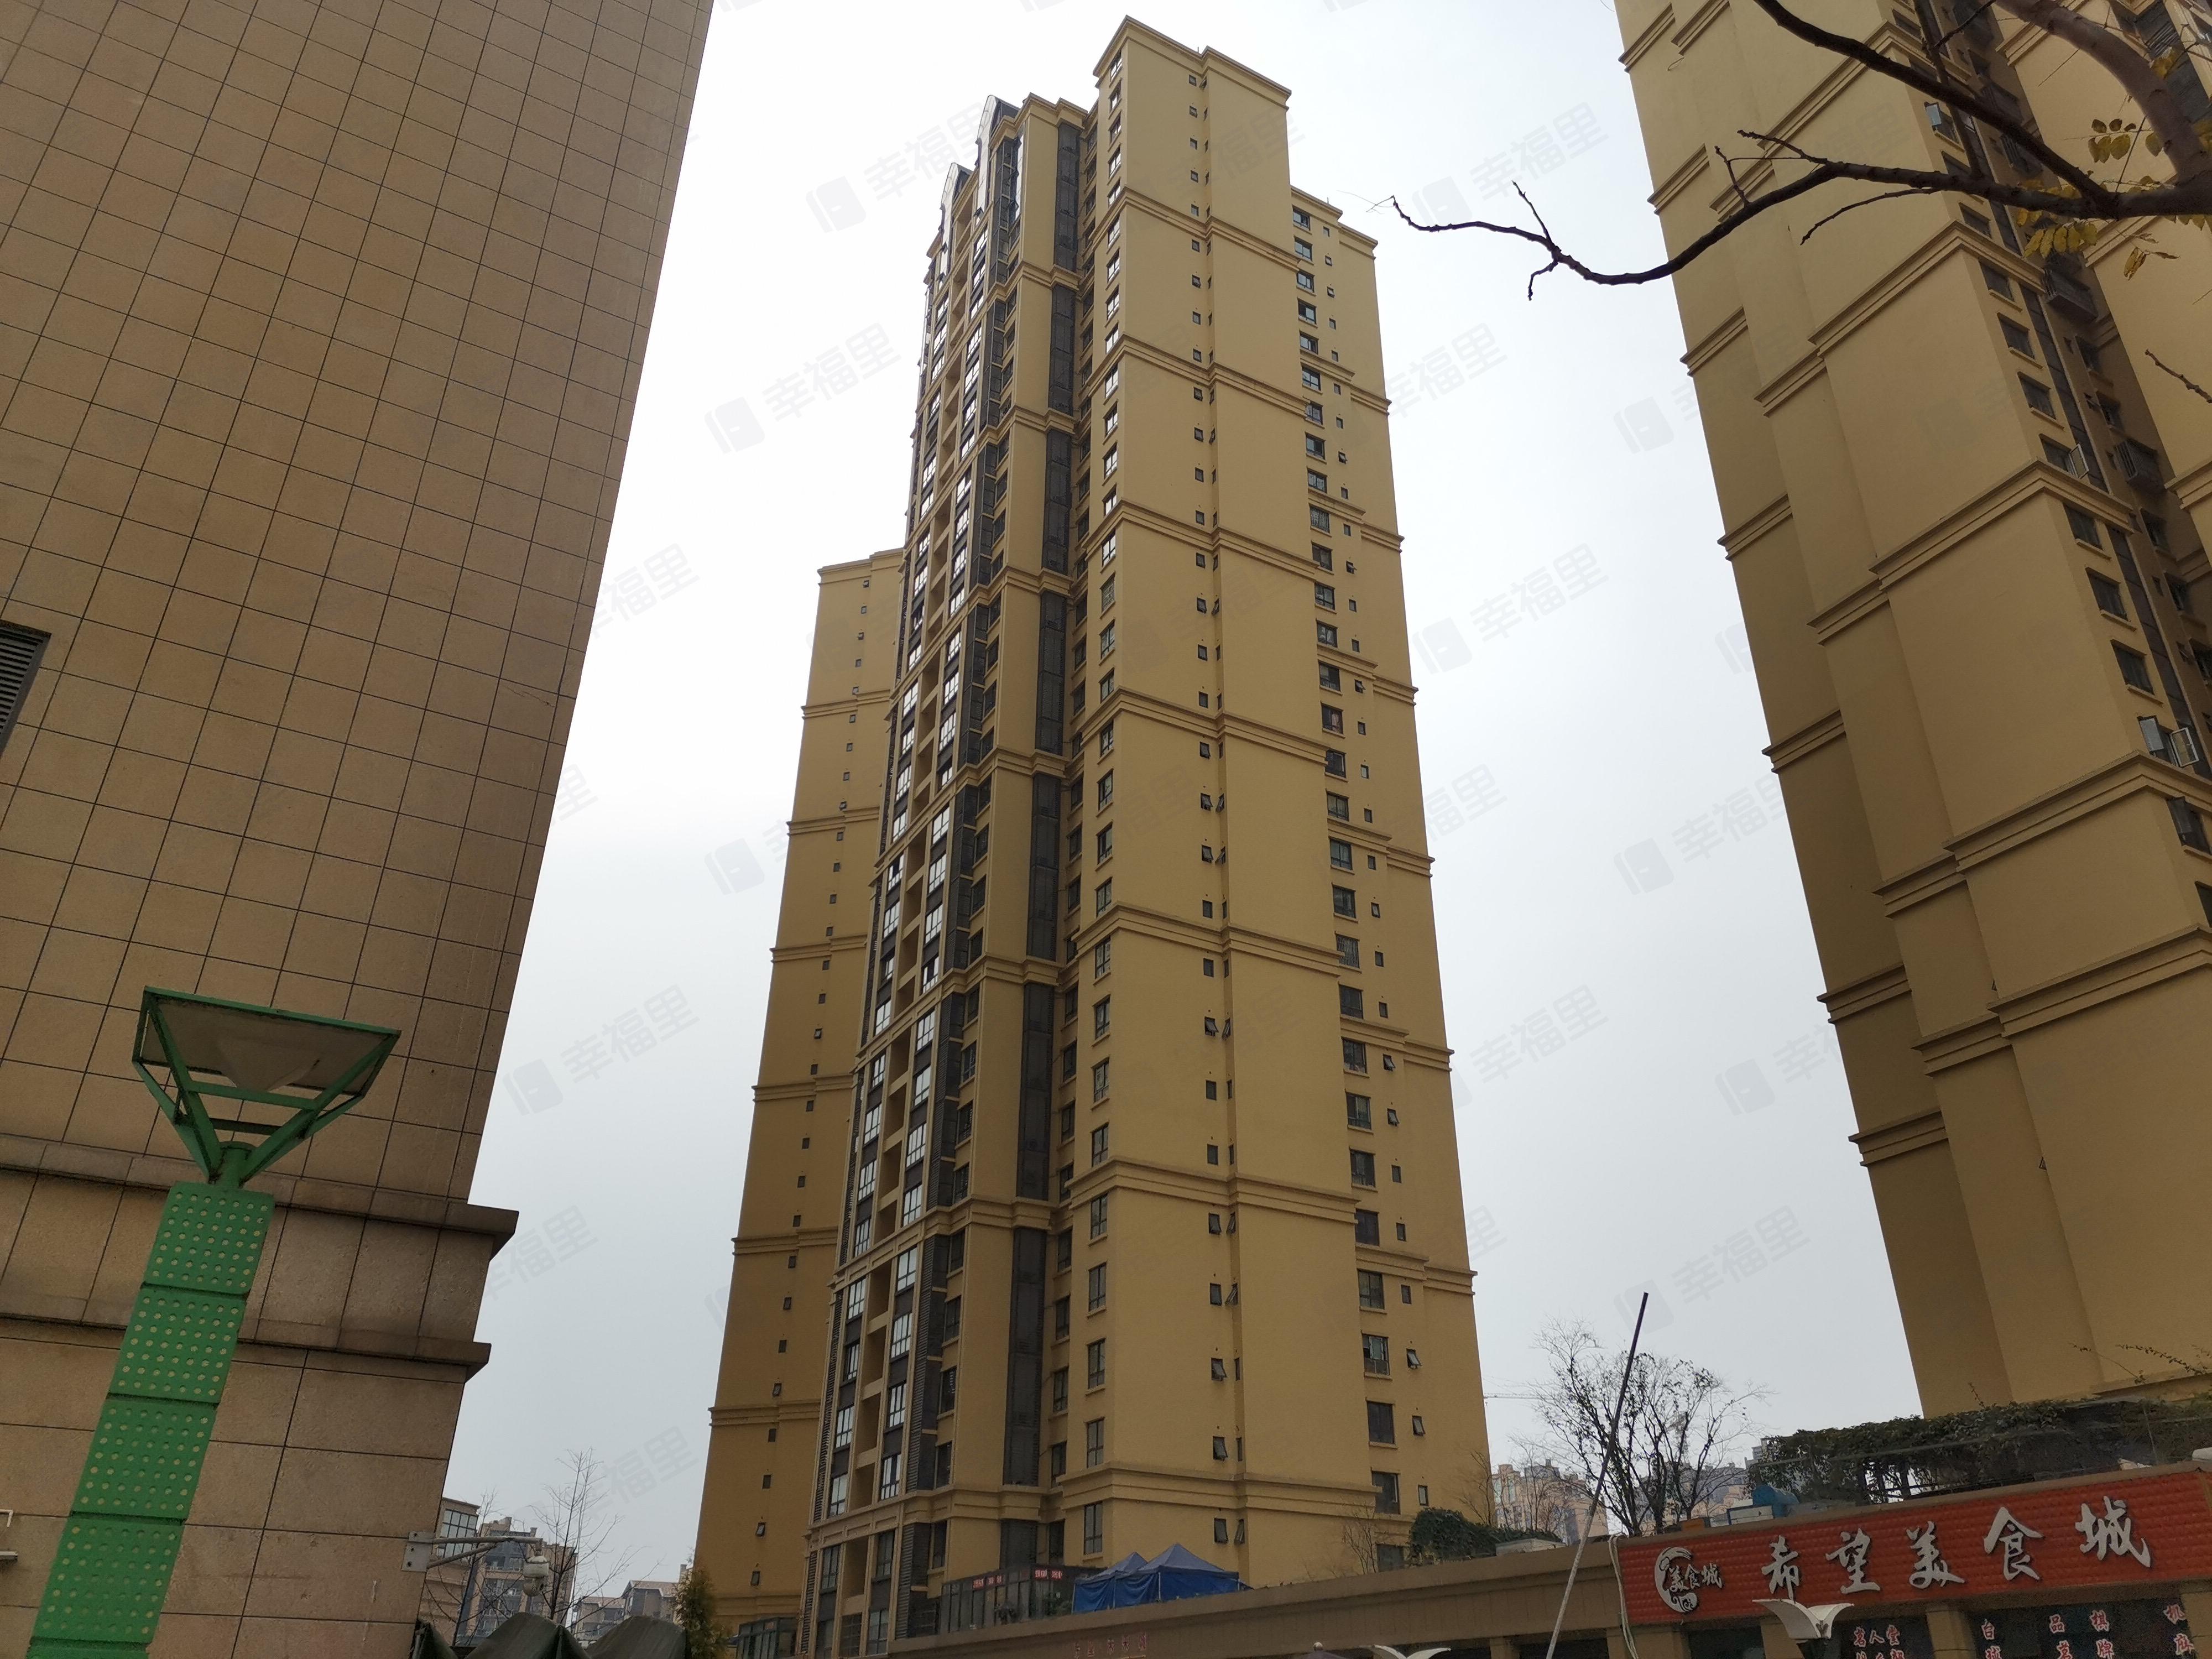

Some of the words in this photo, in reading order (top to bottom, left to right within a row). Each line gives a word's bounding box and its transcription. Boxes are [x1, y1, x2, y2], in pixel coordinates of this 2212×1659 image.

[1669, 1563, 1723, 1592] 美食城
[1761, 1496, 2151, 1600] 希望美食城
